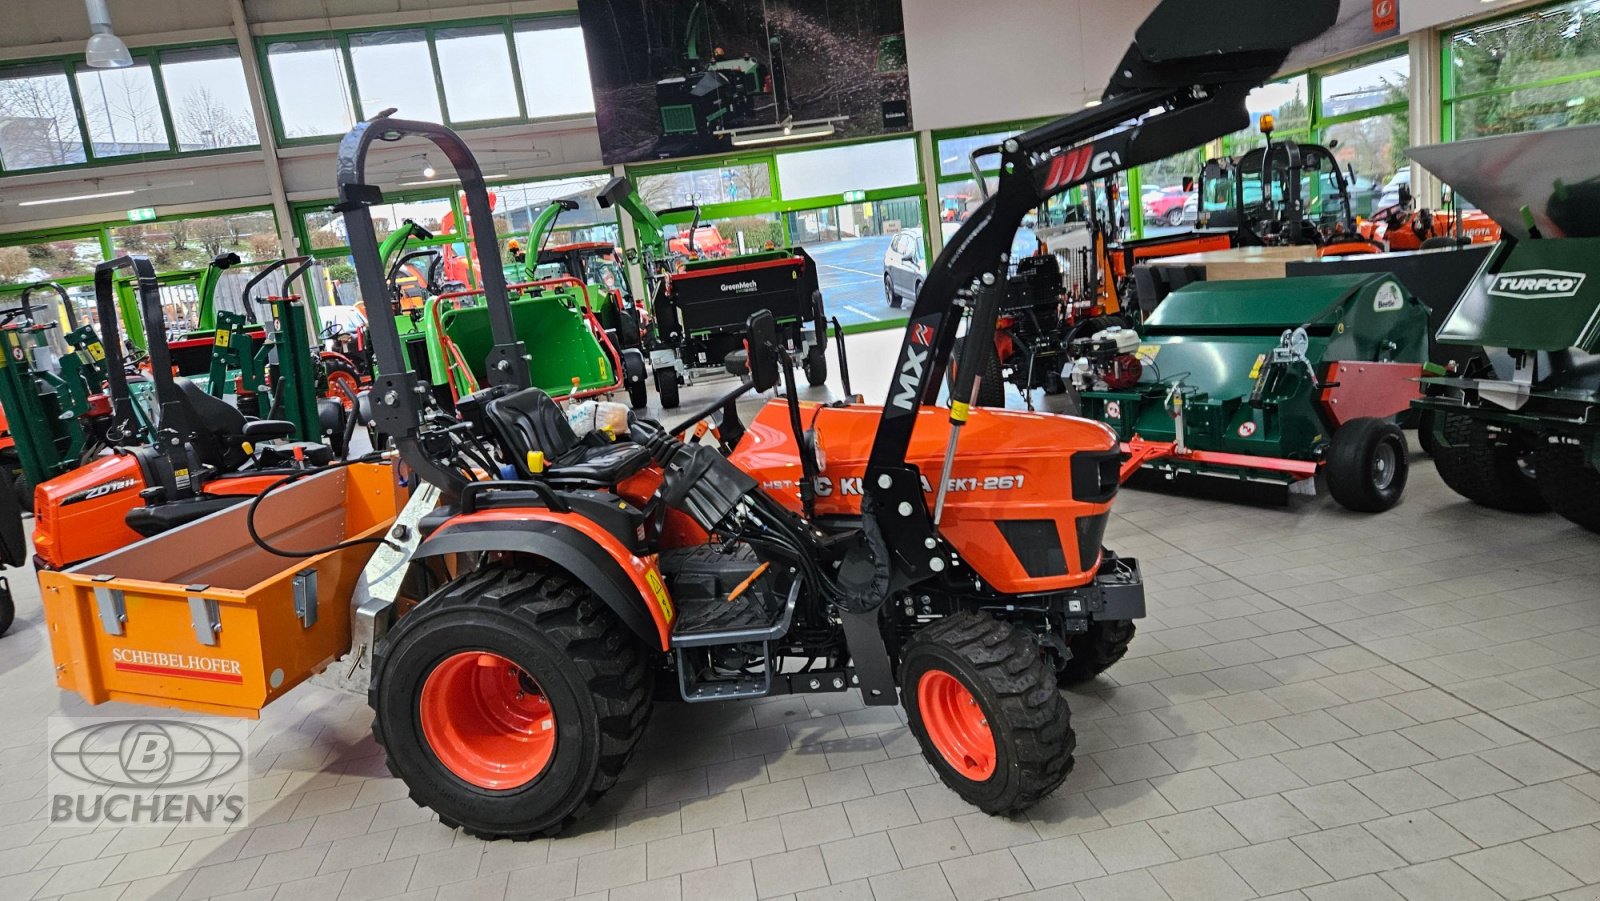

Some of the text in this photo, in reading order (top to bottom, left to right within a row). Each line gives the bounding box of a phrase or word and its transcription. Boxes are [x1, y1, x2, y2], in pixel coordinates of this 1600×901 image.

[721, 280, 757, 291] GreenMech
[1500, 278, 1574, 291] TURFCO
[893, 344, 929, 411] MX
[763, 480, 792, 489] HST
[947, 475, 1025, 492] EK1-261
[112, 647, 241, 674] SCHEIBELHOFER
